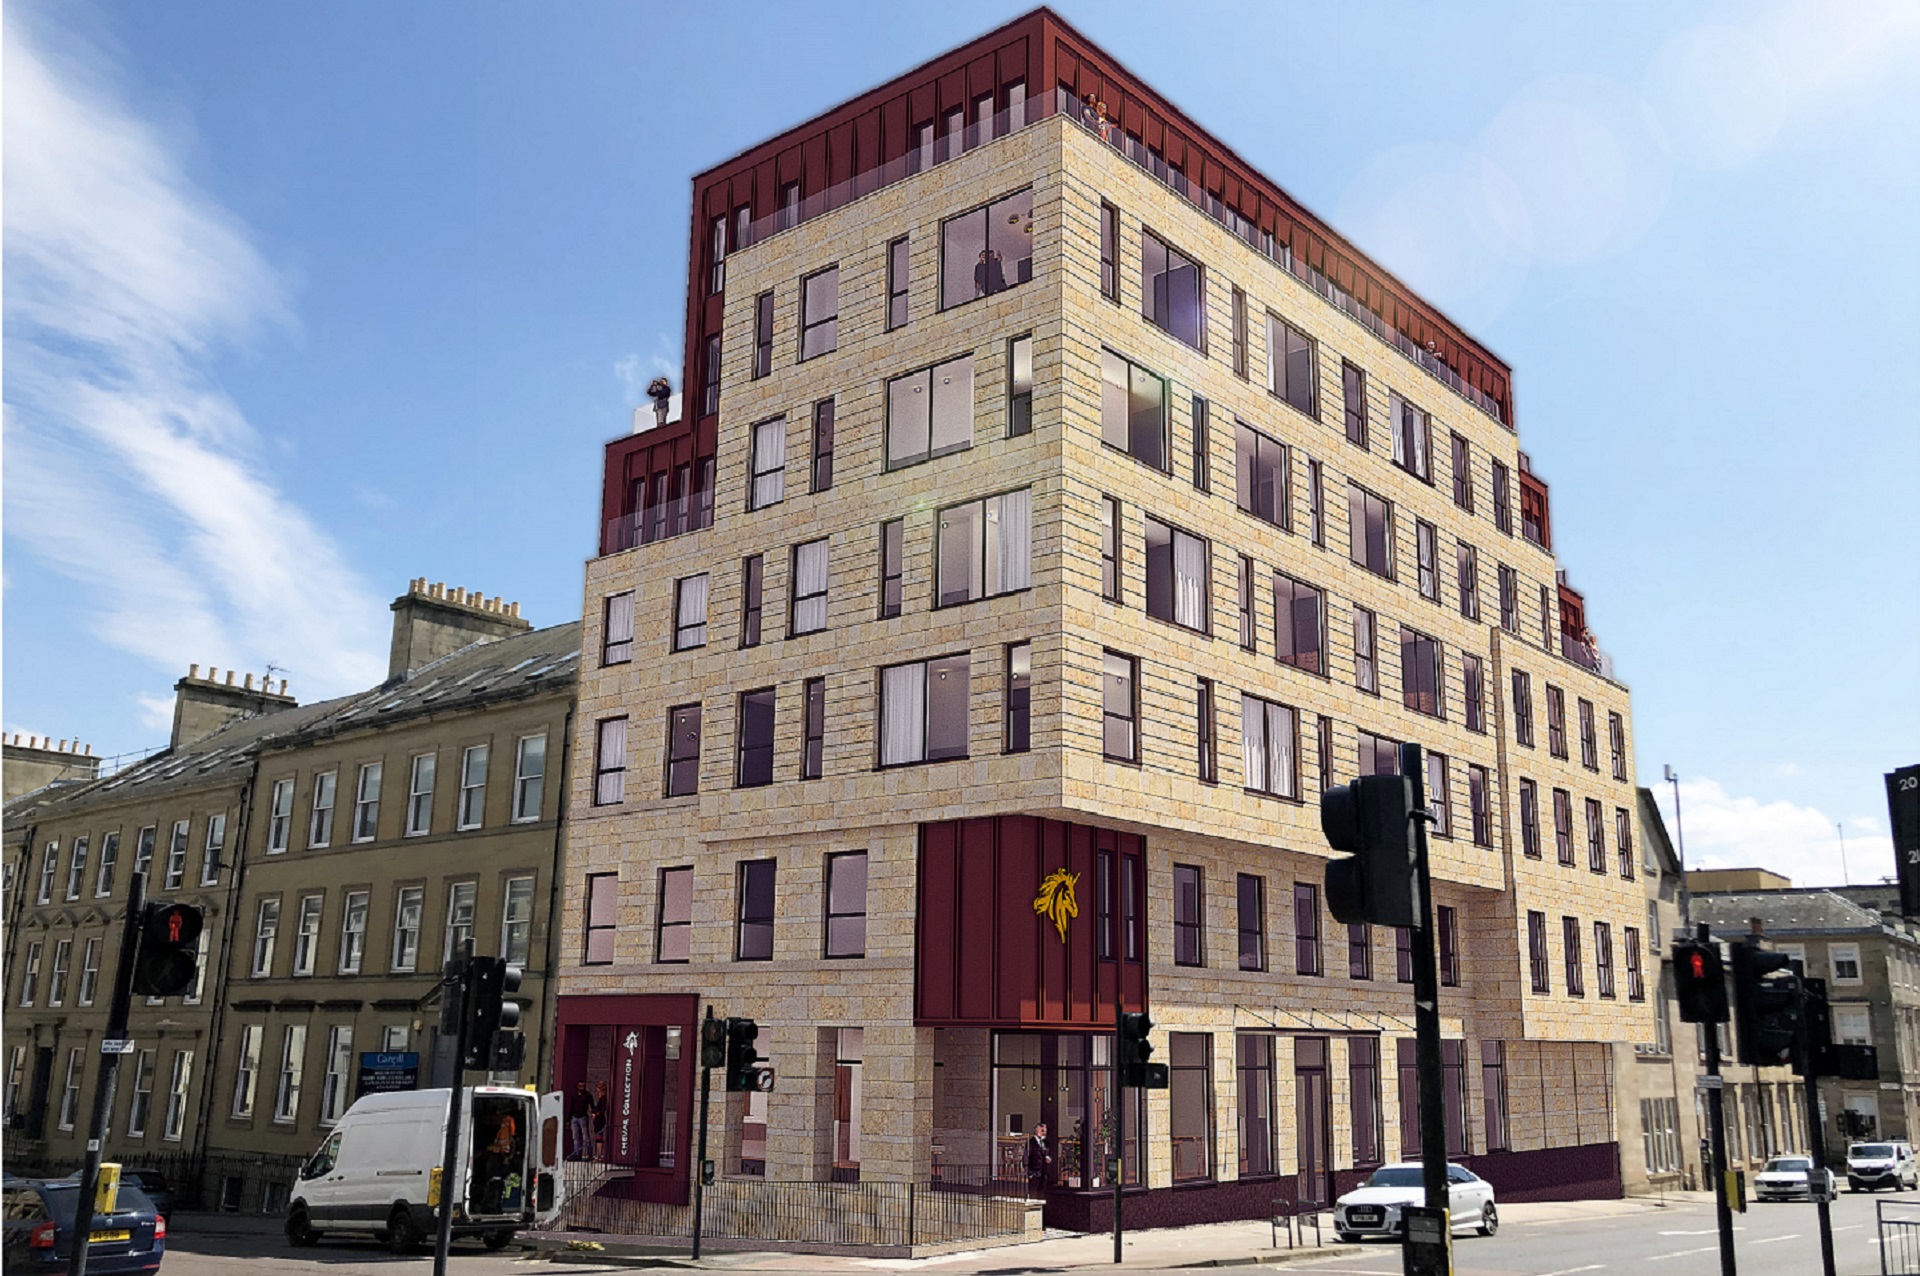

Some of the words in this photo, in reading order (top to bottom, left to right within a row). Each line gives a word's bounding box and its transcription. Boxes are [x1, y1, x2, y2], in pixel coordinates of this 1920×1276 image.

[1899, 776, 1918, 791] 20
[622, 1059, 632, 1115] COLLECTION
[621, 1118, 629, 1155] CHEVAL
